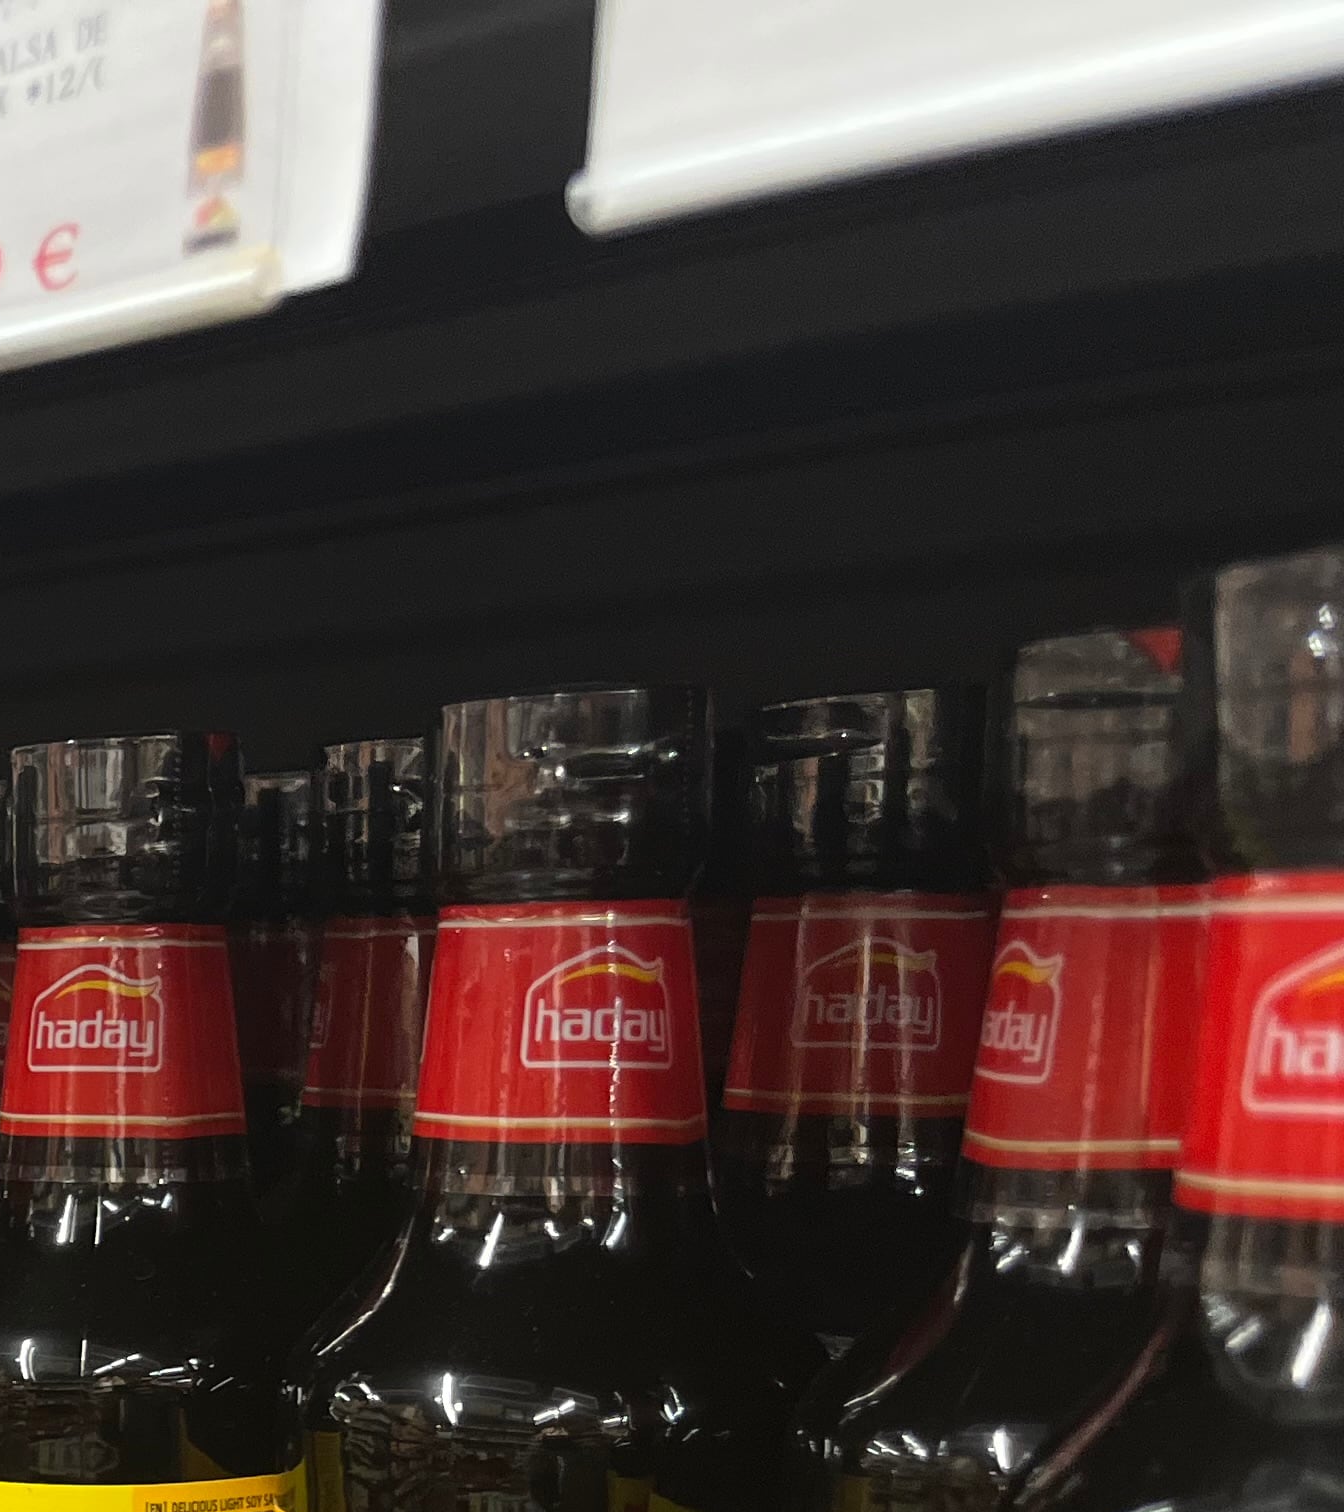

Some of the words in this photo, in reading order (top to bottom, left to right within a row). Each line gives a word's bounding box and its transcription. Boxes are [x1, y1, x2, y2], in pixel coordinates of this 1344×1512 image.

[76, 12, 107, 53] DE
[32, 222, 80, 291] €
[35, 1010, 155, 1058] haday
[534, 996, 669, 1052] haday
